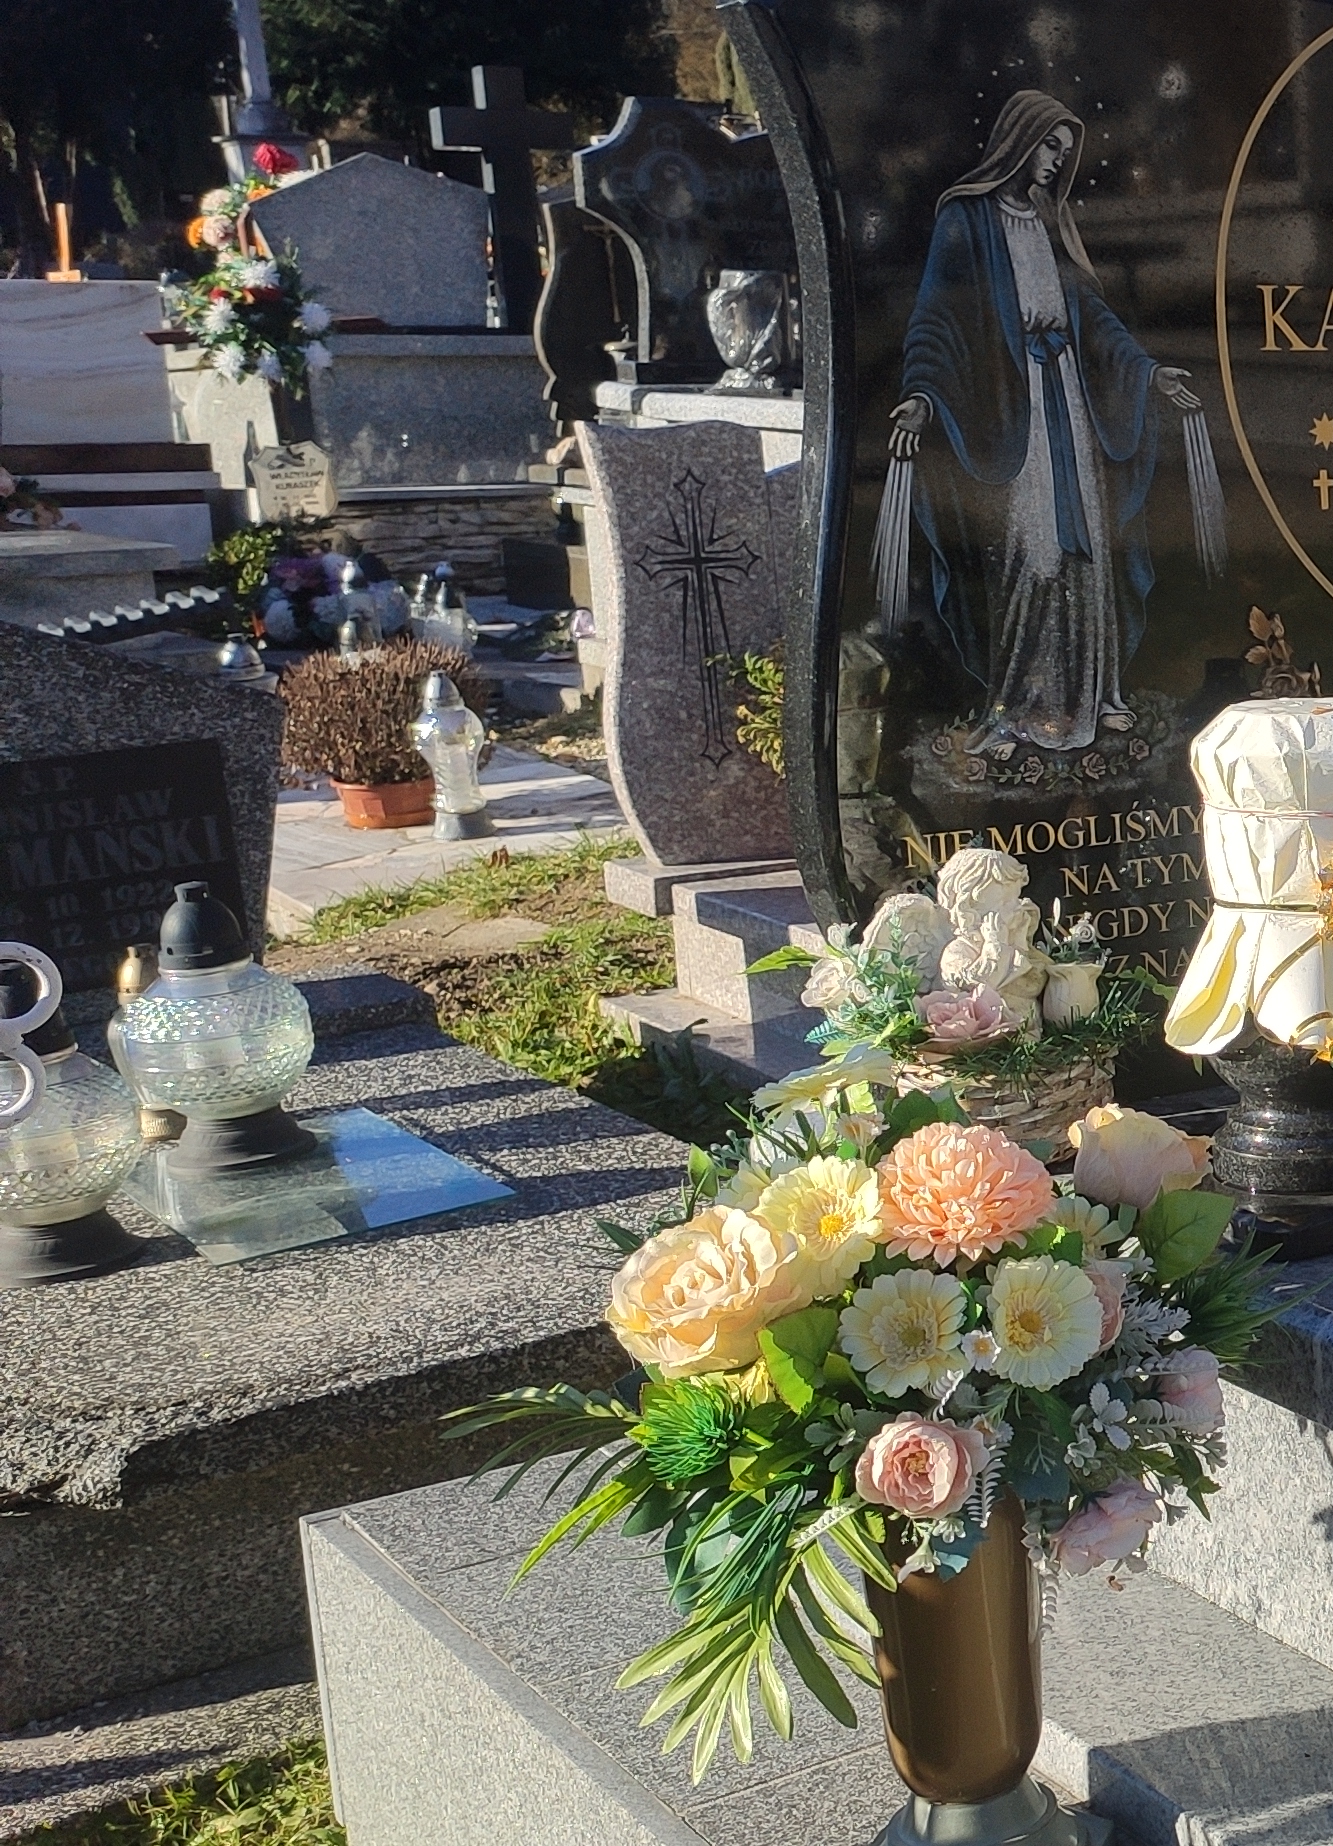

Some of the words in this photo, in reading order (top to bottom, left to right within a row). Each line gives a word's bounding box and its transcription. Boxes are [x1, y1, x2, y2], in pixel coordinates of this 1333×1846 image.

[0, 788, 173, 837] NISŁAW
[986, 800, 1205, 856] MOGLIŚMY
[1059, 862, 1121, 899] NA
